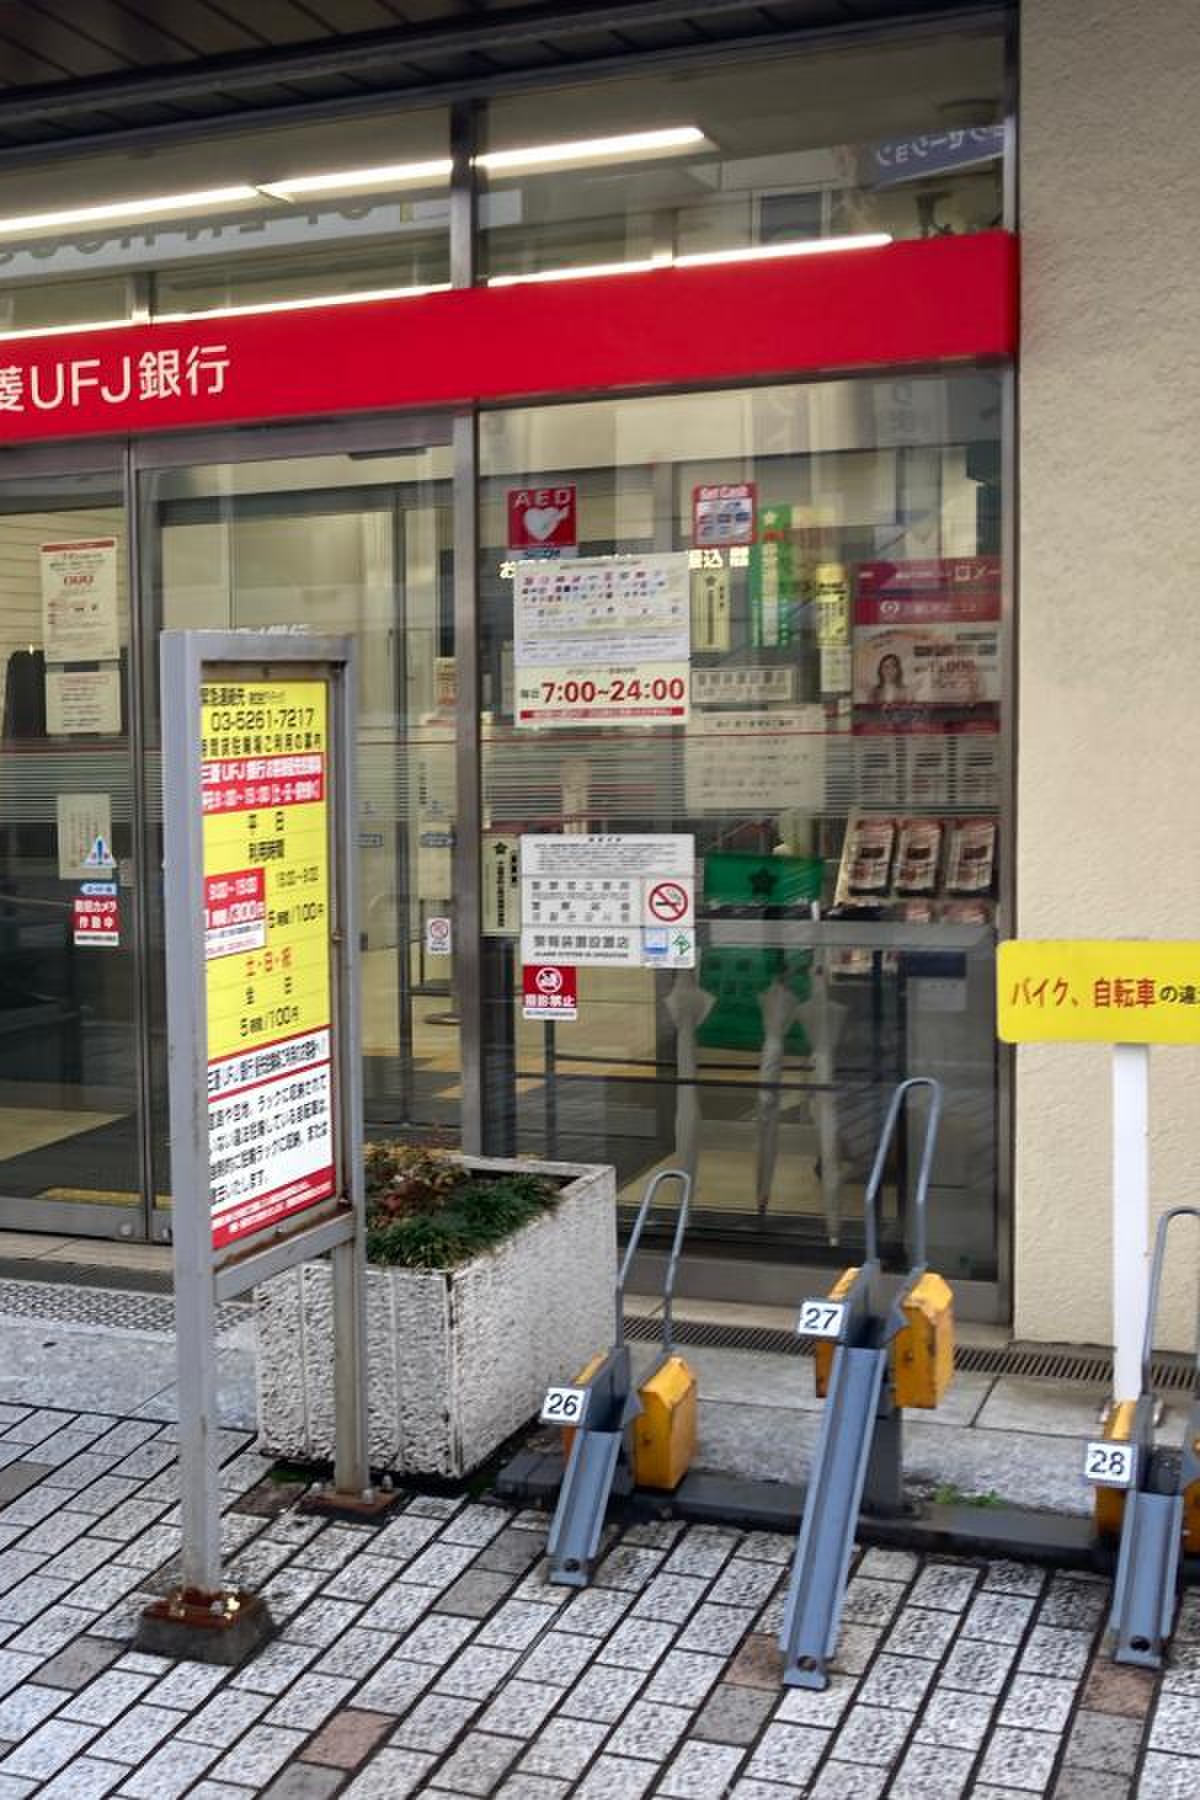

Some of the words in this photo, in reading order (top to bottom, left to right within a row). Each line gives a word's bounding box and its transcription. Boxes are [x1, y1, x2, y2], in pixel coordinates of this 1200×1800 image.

[514, 488, 571, 508] AED
[1011, 977, 1199, 1008] バイク、自転車の違
[804, 1307, 838, 1331] 27
[548, 1393, 578, 1416] 26
[1089, 1449, 1125, 1475] 28
